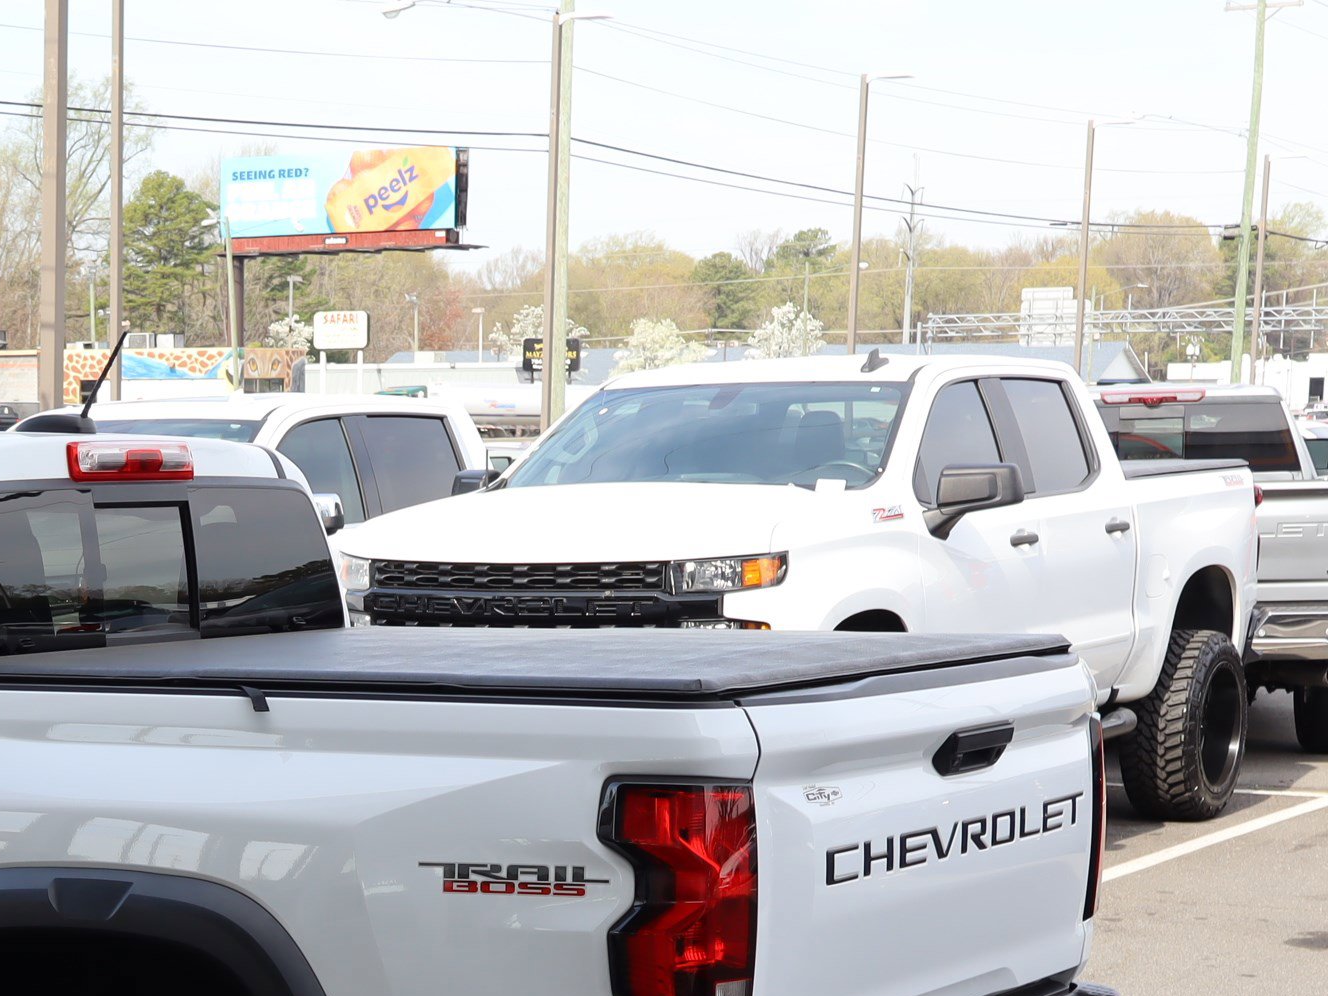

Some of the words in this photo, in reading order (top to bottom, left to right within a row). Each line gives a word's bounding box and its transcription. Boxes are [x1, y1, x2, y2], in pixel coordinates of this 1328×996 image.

[232, 170, 275, 181] SEEING
[278, 168, 309, 178] RED?
[364, 165, 419, 215] peelz
[323, 312, 359, 324] SAFARI
[373, 596, 654, 616] CHEVROLET
[825, 790, 1085, 886] CHEVROLET
[418, 862, 610, 883] TRAIL
[443, 880, 586, 896] BOSS
